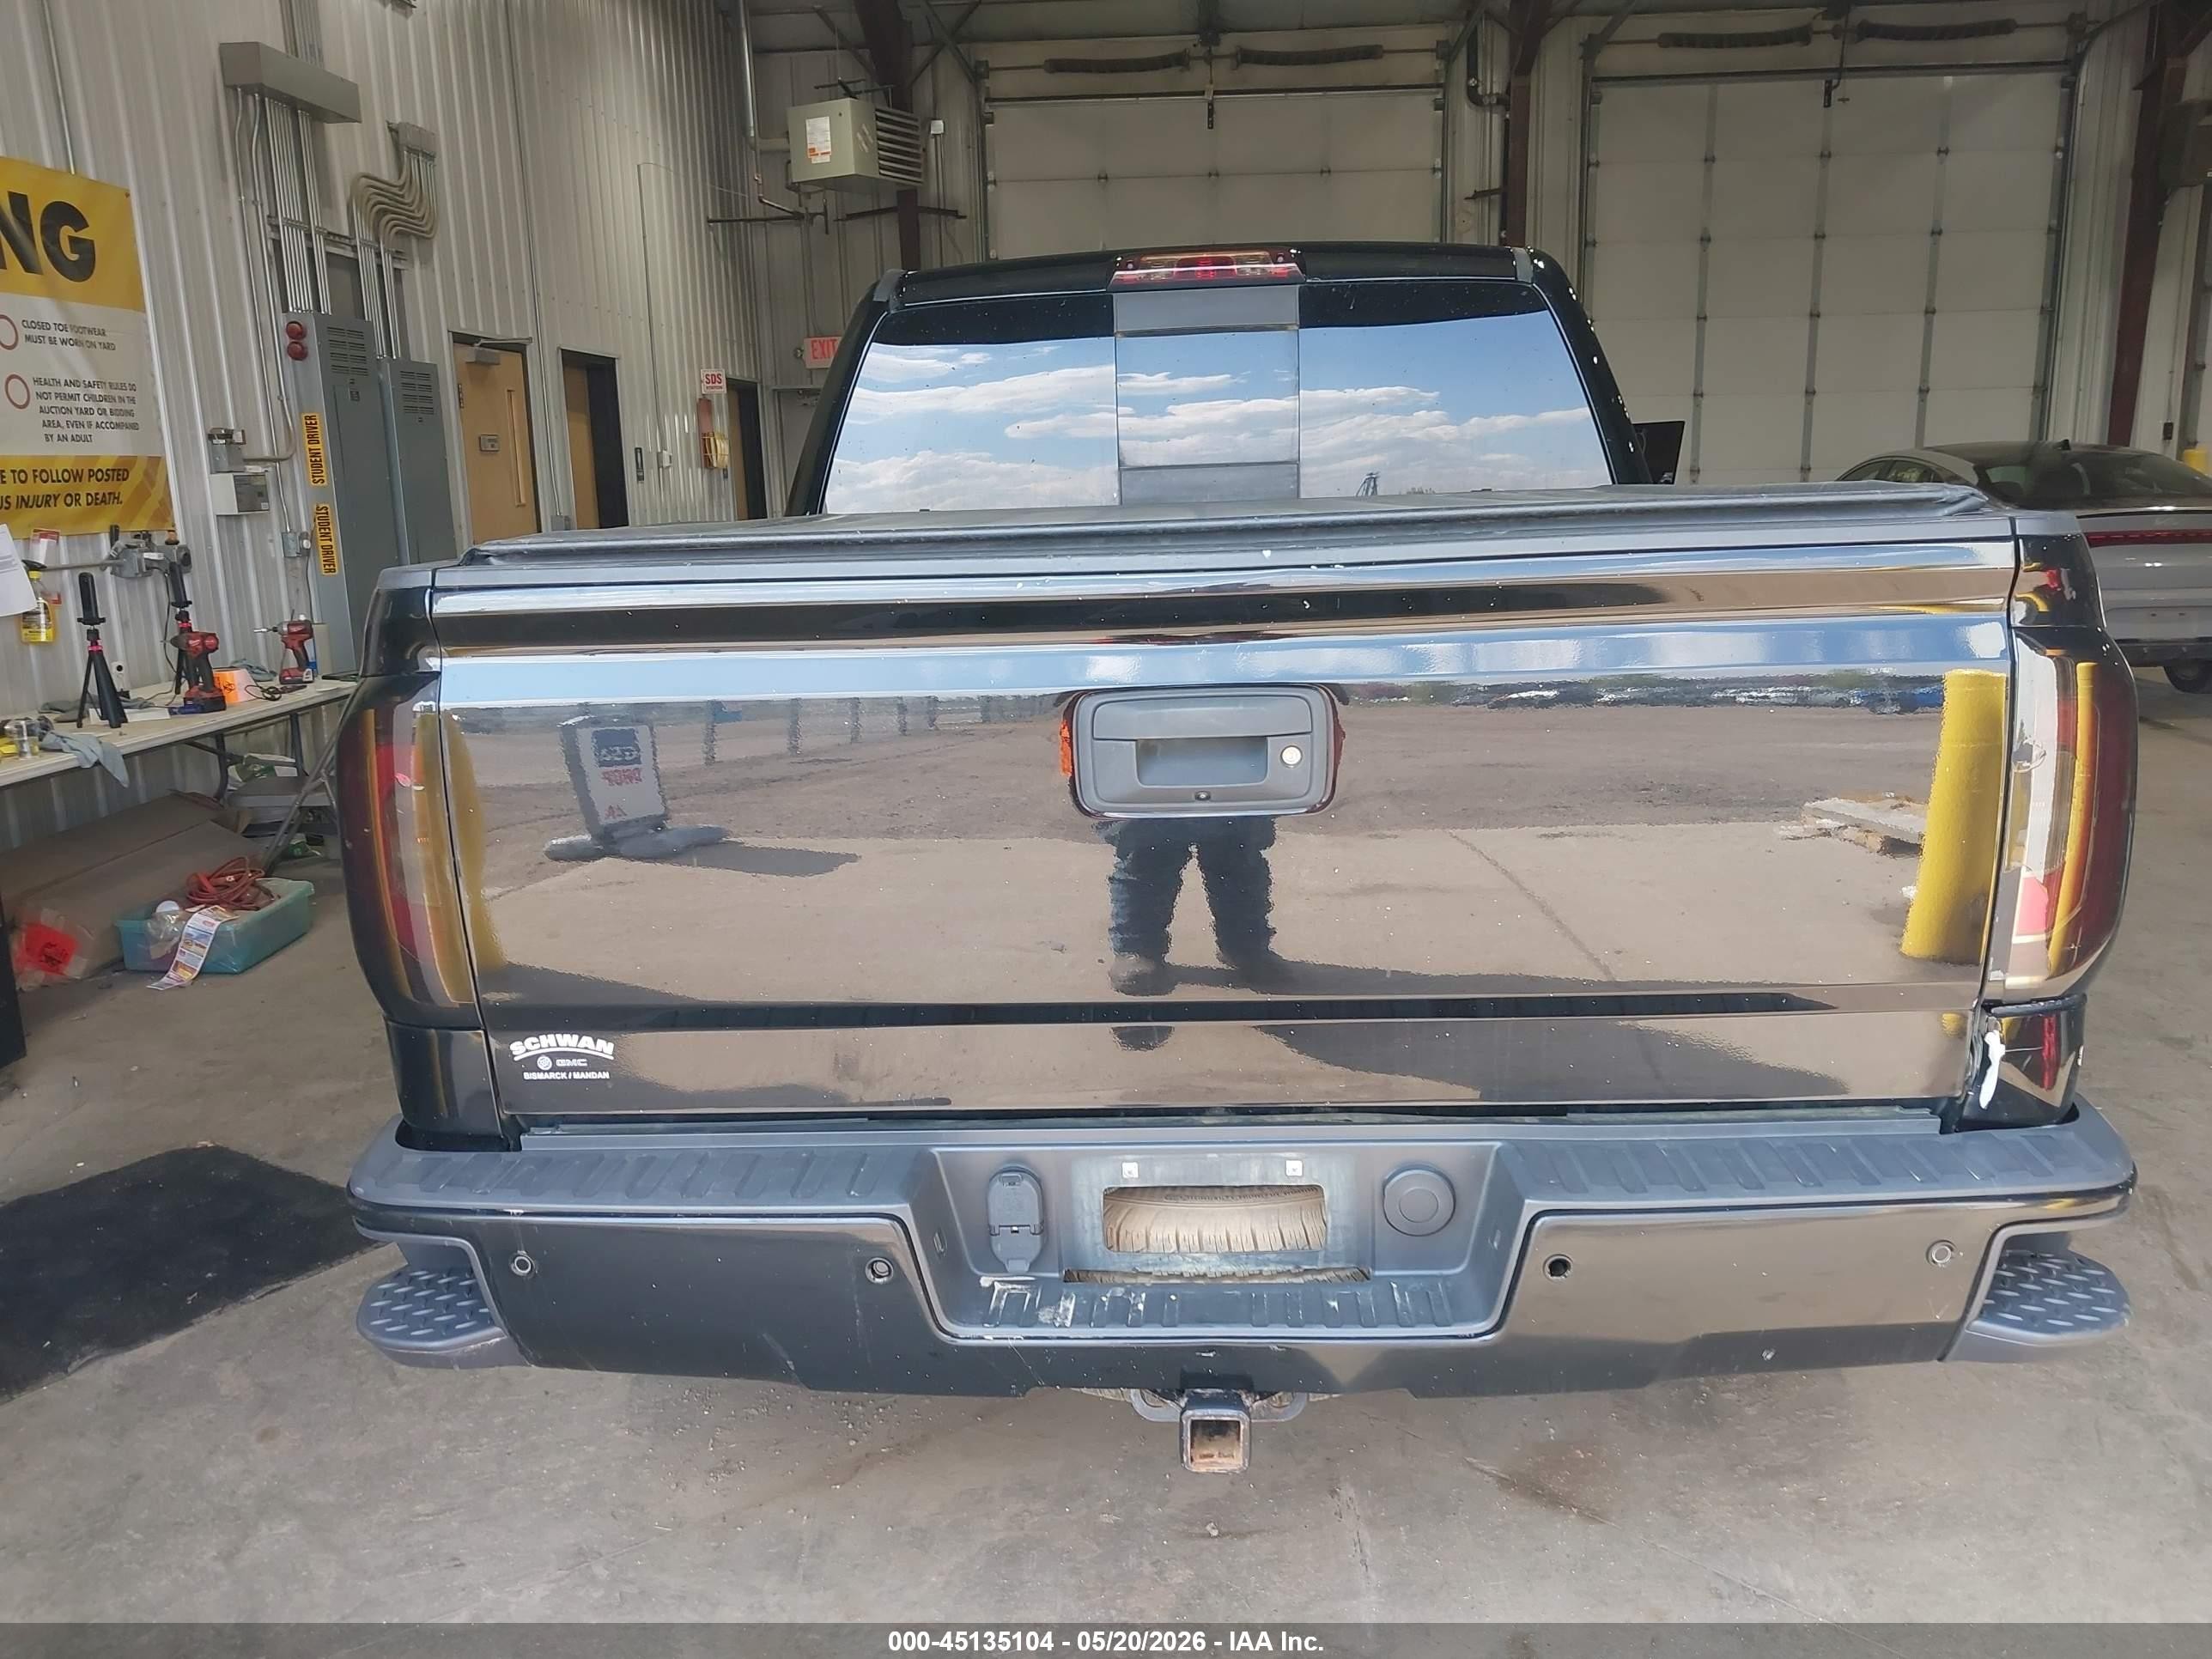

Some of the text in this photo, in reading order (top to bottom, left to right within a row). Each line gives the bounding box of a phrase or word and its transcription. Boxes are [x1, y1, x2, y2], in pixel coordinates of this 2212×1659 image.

[21, 319, 106, 337] CLOSED TOE FOOTWEAR
[24, 334, 116, 351] MUST BE WORN ON YARD
[811, 339, 838, 360] EXIT
[33, 378, 61, 387] HEALTH
[64, 379, 81, 388] AND
[82, 380, 106, 390] SAFETY
[705, 373, 723, 385] SDS
[35, 392, 52, 400] NOT
[54, 392, 81, 402] PERMIT
[83, 393, 116, 403] CHILDREN
[40, 405, 72, 415] AUCTION
[74, 406, 94, 416] YARD
[97, 408, 107, 416] OR
[42, 419, 64, 430] AREA,
[65, 420, 84, 429] EVEN
[45, 433, 53, 442] BY
[57, 434, 68, 442] AN
[304, 415, 325, 484] STUDENT DRIVER
[10, 468, 28, 484] TO
[33, 468, 84, 483] FOLLOW
[88, 468, 130, 483] POSTED
[15, 494, 61, 509] INJURY
[64, 493, 82, 507] OR
[86, 492, 123, 507] DEATH.
[316, 506, 337, 574] STUDENT DRIVER
[509, 1033, 615, 1055] SCHWAN
[523, 1072, 568, 1080] BISMARCK
[573, 1071, 610, 1079] MANDAN
